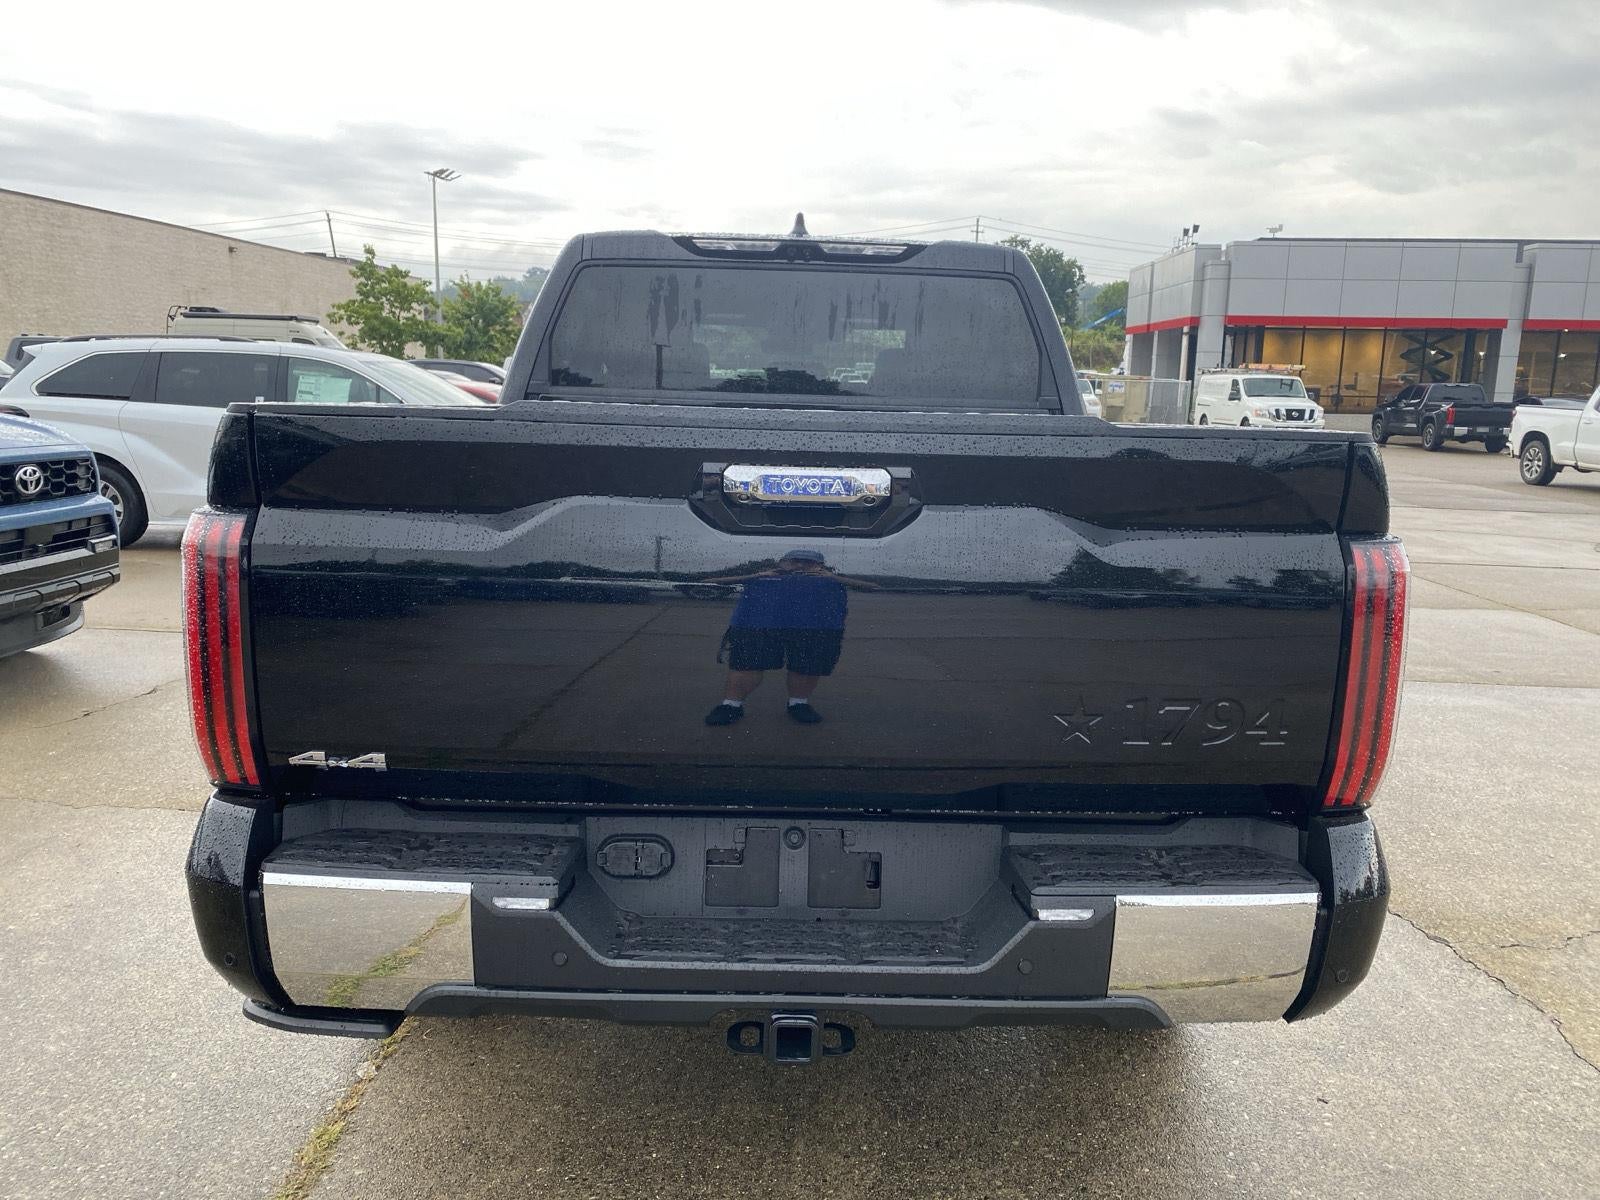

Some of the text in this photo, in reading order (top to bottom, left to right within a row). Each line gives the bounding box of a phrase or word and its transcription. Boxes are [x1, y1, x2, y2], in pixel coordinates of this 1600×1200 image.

[768, 477, 845, 494] TOYOTA
[1121, 697, 1289, 746] 1794
[288, 750, 387, 771] 4x4
